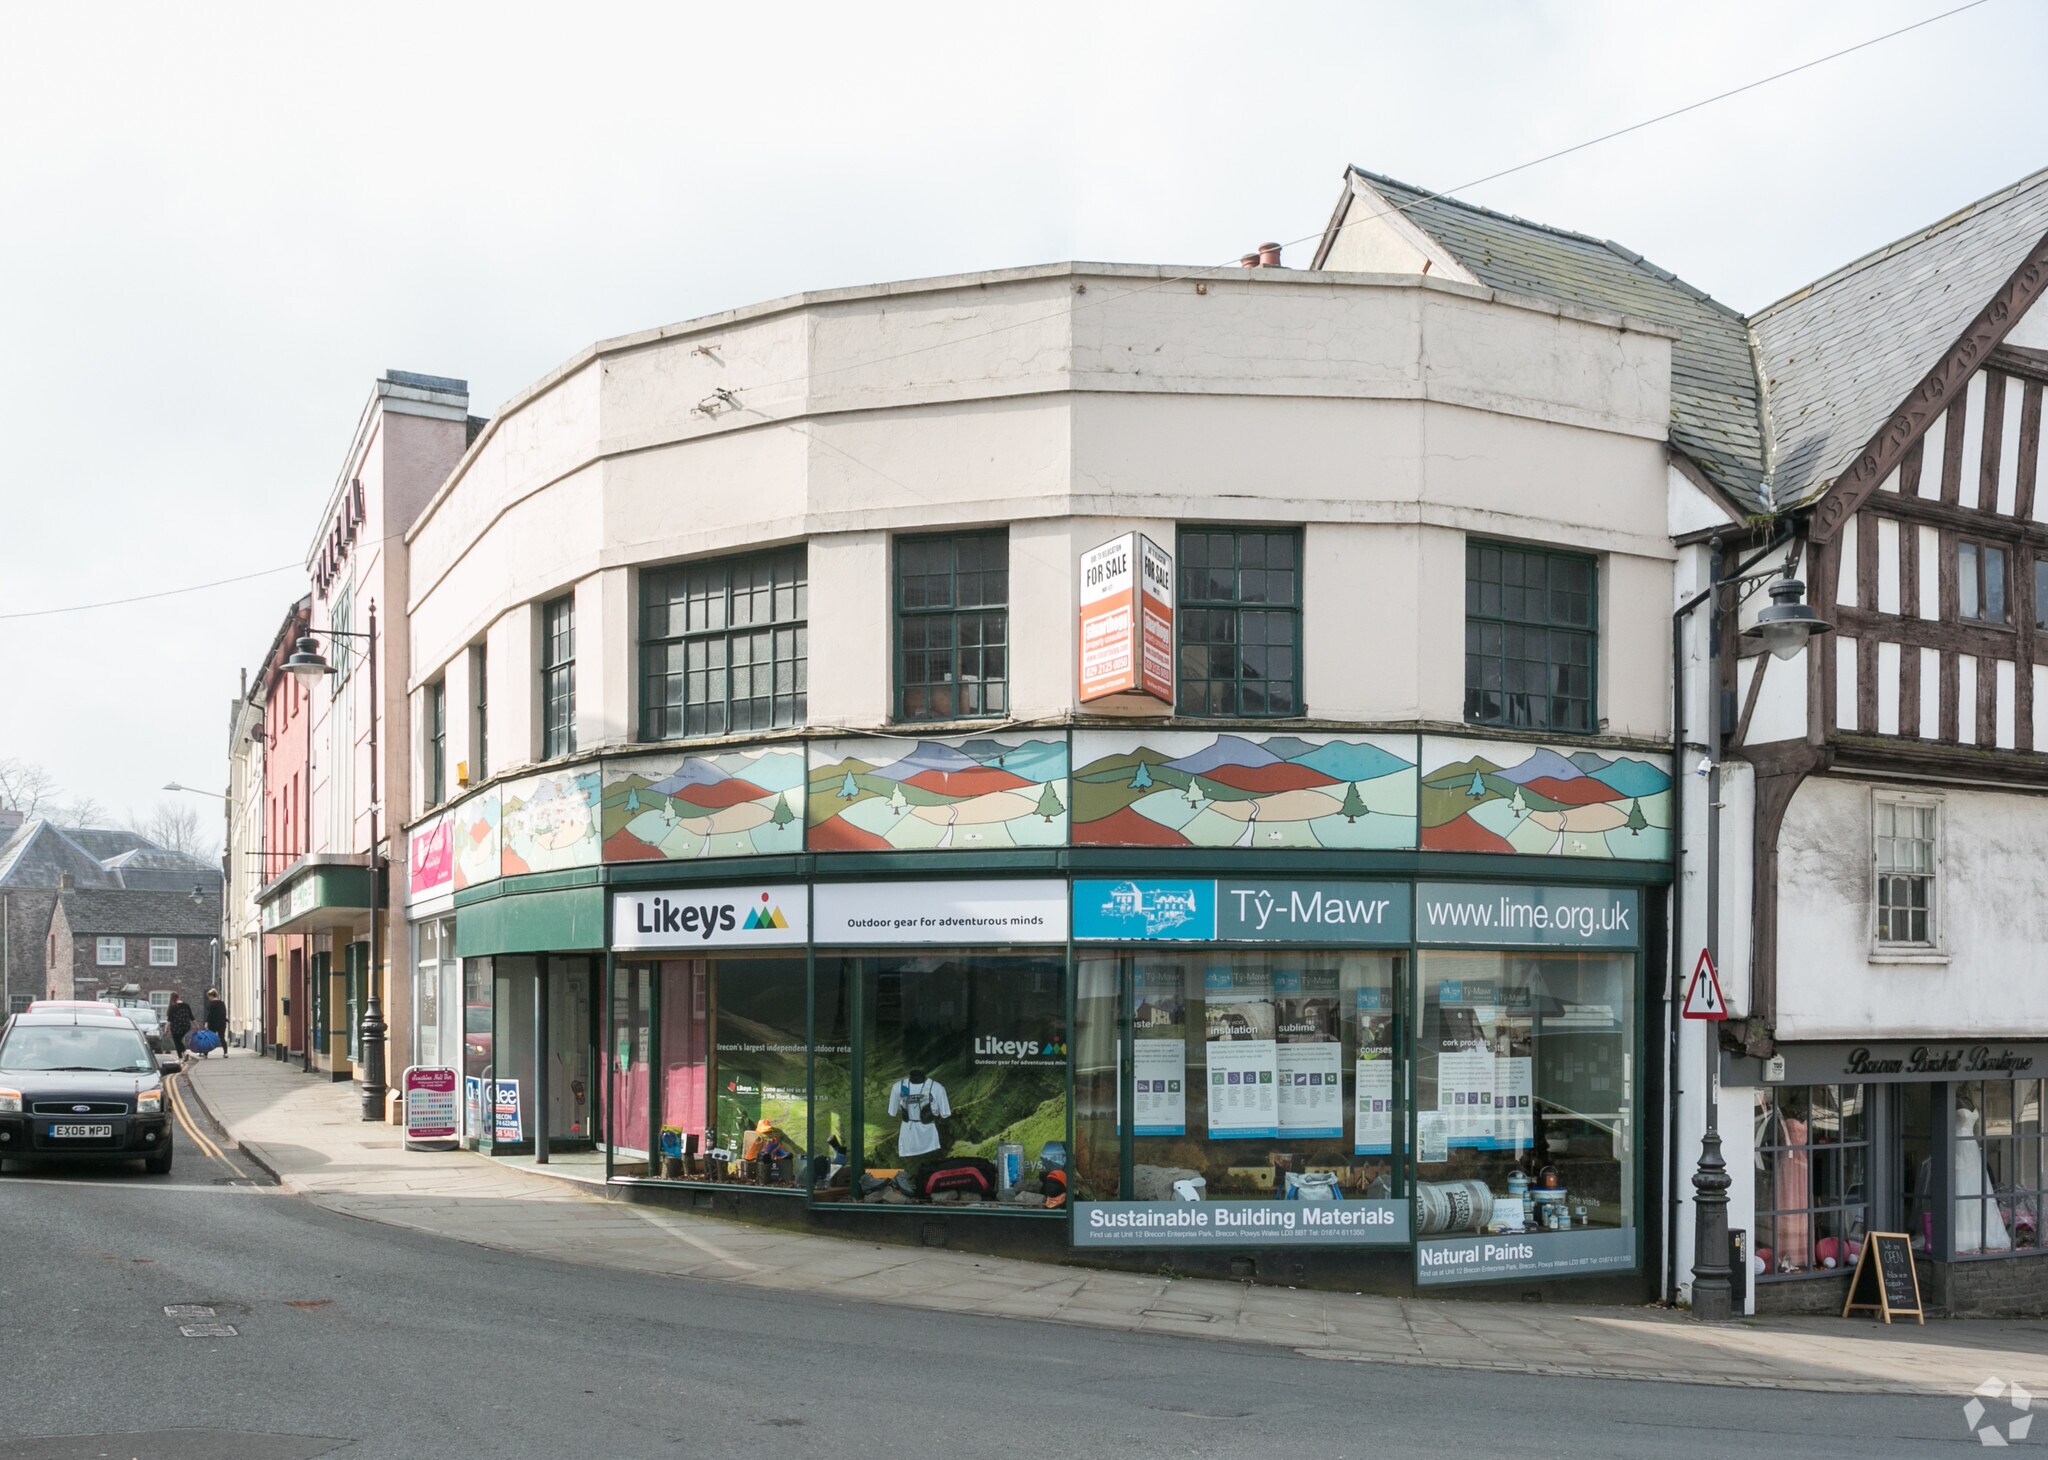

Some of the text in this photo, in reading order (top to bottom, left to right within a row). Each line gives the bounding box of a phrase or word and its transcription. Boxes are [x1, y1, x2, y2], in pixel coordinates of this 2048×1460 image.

[1086, 564, 1104, 587] FOR
[1105, 553, 1127, 580] SALE
[1145, 555, 1155, 581] FOR
[1156, 564, 1169, 590] SALE
[1230, 889, 1390, 930] Tŷ-Mawr
[637, 897, 736, 940] Likeys
[847, 915, 1044, 929] Outdoor gear for adventurous minds
[1426, 897, 1630, 938] www.lime.org.uk
[1134, 1020, 1154, 1029] ster
[1210, 1025, 1258, 1035] insulation
[1278, 1023, 1316, 1032] sublime
[744, 1043, 766, 1053] largest
[766, 1043, 808, 1053] independent
[814, 1044, 836, 1053] utdoor
[836, 1045, 852, 1053] reta
[974, 1035, 1039, 1059] Likeys
[1442, 1039, 1459, 1047] cork
[1360, 1046, 1393, 1054] courses
[56, 1126, 111, 1136] EX06 WPD
[1568, 1194, 1600, 1207] Site visits
[1090, 1207, 1395, 1229] Sustainable Building Materials
[1167, 1230, 1197, 1239] Enterprise
[1198, 1230, 1214, 1238] Park,
[1215, 1230, 1238, 1238] Brecon,
[1240, 1230, 1261, 1238] Powys
[1295, 1229, 1307, 1237] 8BT
[1309, 1229, 1319, 1237] Tel:
[1420, 1243, 1533, 1266] Natural Paints
[1481, 1265, 1505, 1273] Enterprise
[1537, 1261, 1554, 1269] Powys
